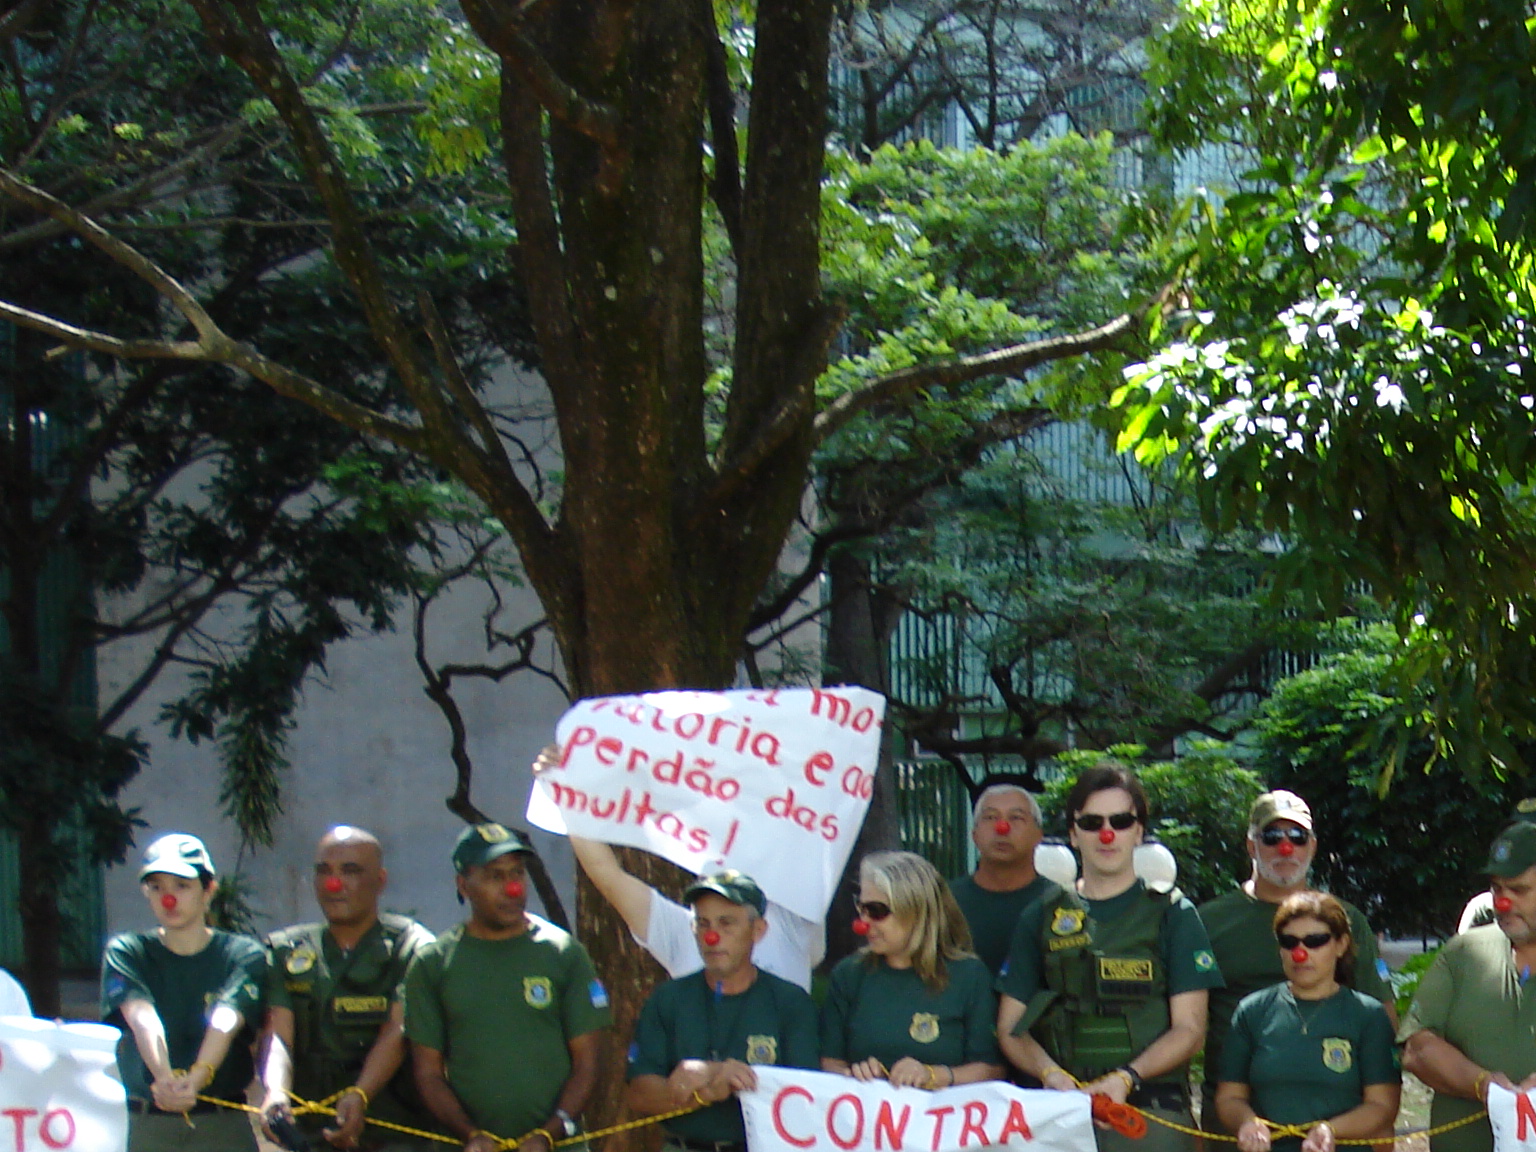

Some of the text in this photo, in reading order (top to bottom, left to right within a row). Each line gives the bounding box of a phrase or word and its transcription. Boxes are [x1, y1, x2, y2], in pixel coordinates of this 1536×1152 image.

[559, 726, 839, 842] perdão das
[805, 750, 834, 787] e
[772, 1086, 1035, 1151] CONTRA
